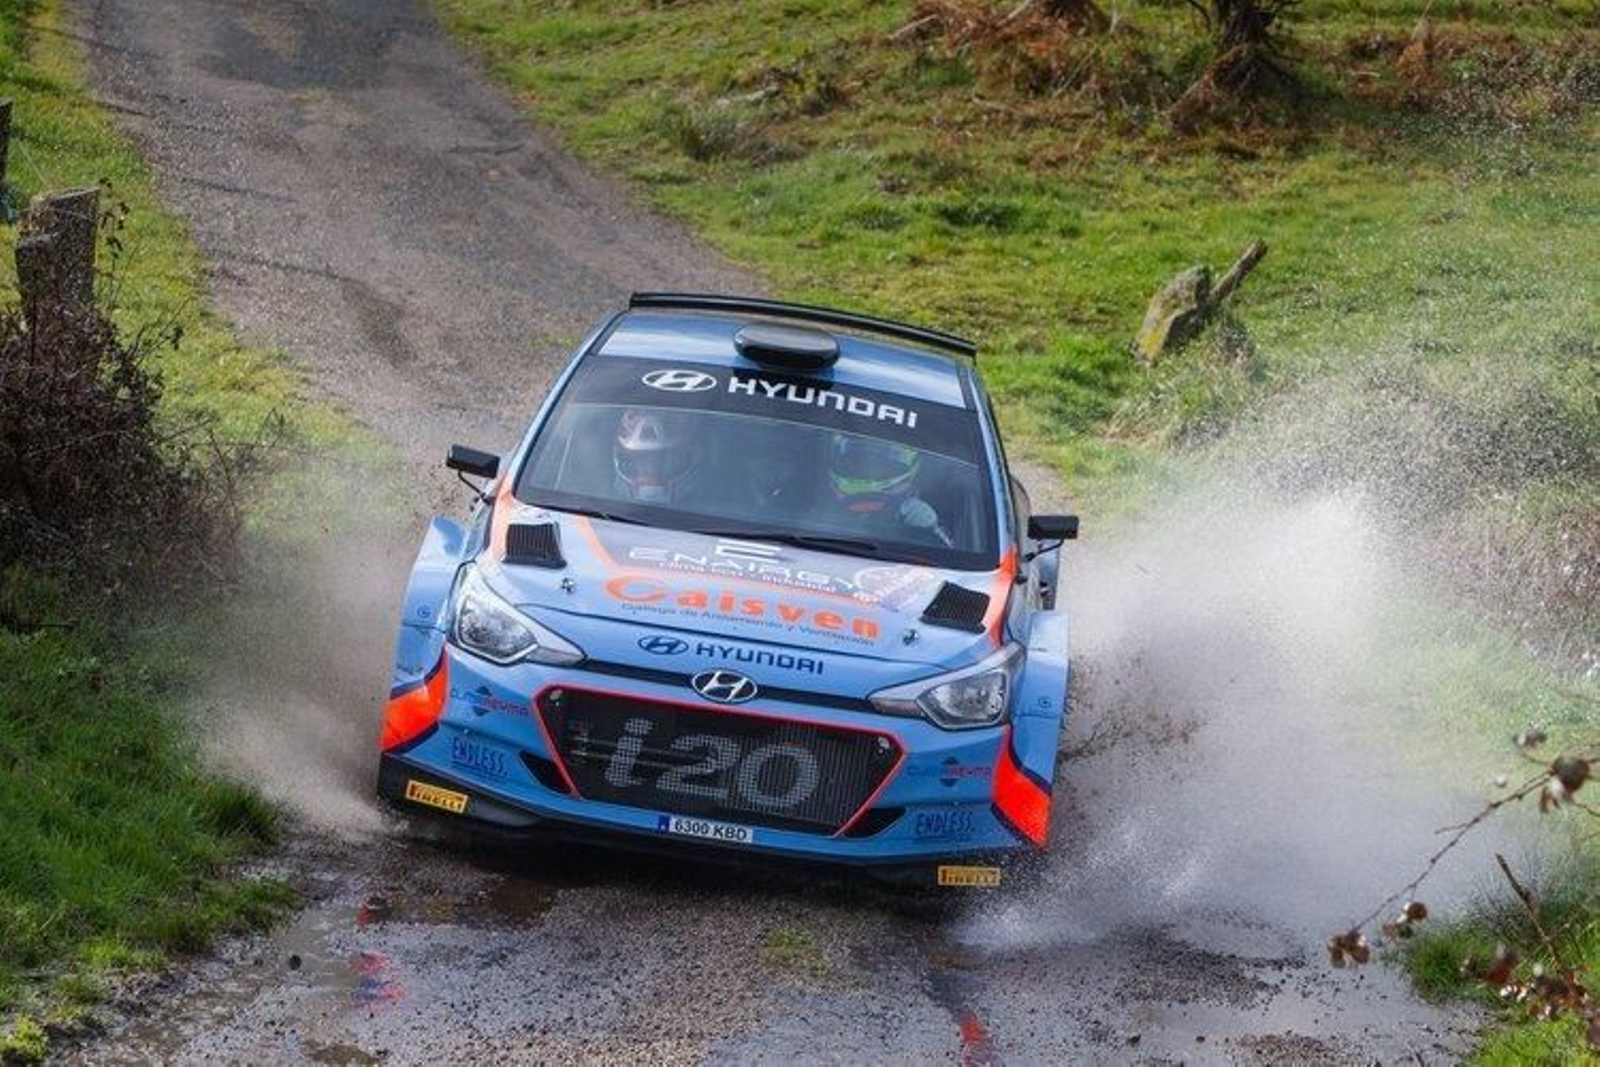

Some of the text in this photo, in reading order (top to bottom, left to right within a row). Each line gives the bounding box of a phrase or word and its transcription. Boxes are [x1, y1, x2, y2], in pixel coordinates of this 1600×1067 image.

[727, 376, 919, 428] HYUNDAI
[605, 575, 880, 638] Caisven
[695, 642, 824, 675] HYUNDAI
[604, 717, 820, 807] i20
[674, 818, 748, 841] 6300 KBD
